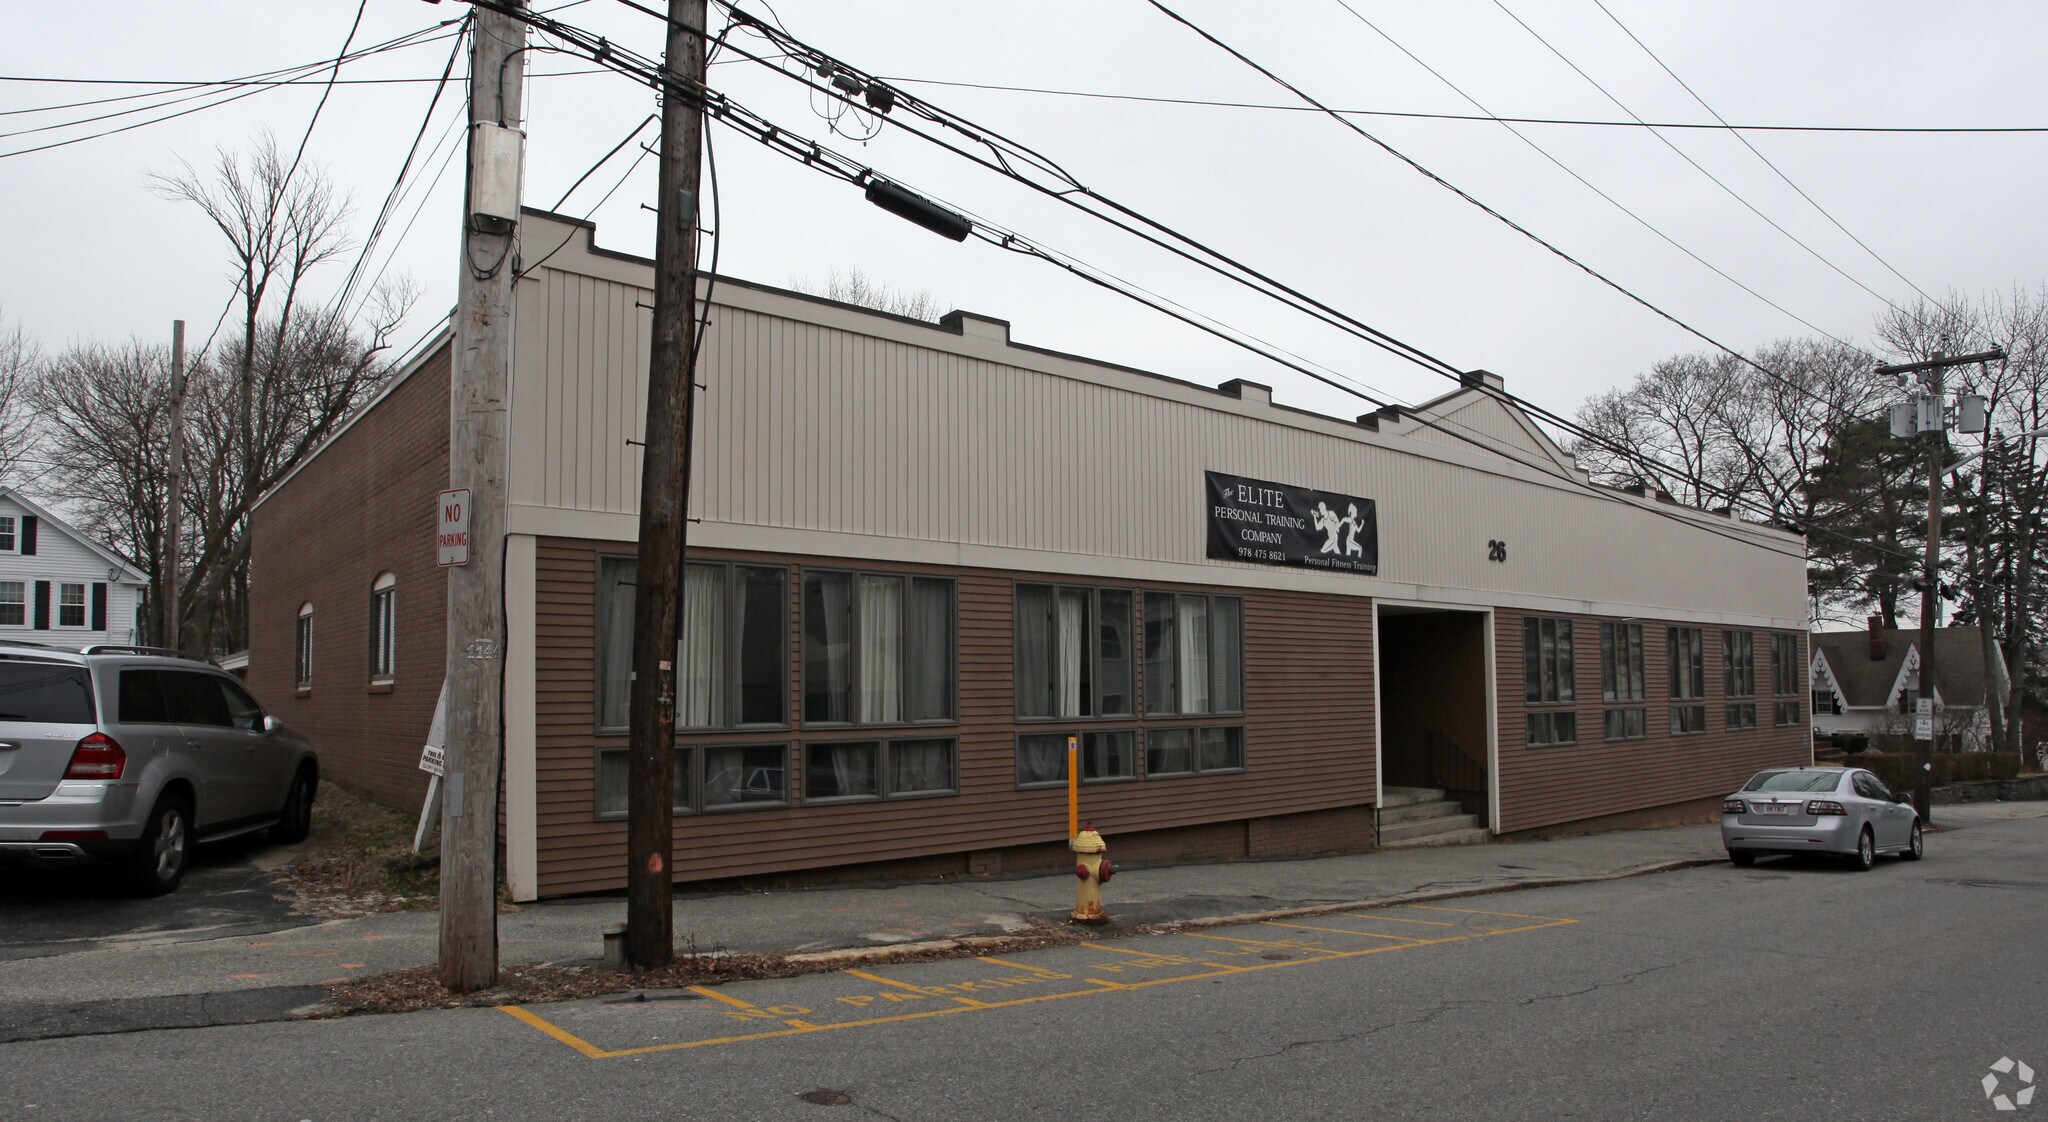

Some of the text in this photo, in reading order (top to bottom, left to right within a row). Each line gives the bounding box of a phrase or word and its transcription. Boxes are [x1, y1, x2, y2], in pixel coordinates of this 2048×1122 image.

[1238, 484, 1284, 508] ELITE
[445, 504, 461, 523] NO
[1214, 506, 1305, 529] PERSONAL TRAINING
[439, 532, 467, 548] PARKING
[1241, 529, 1283, 544] COMPANY
[1238, 547, 1286, 561] 978 475 8621
[1488, 540, 1507, 562] 26
[1304, 555, 1377, 574] Personal Fitness Training
[423, 755, 443, 767] PARKING
[721, 971, 1073, 1020] NO PARKING
